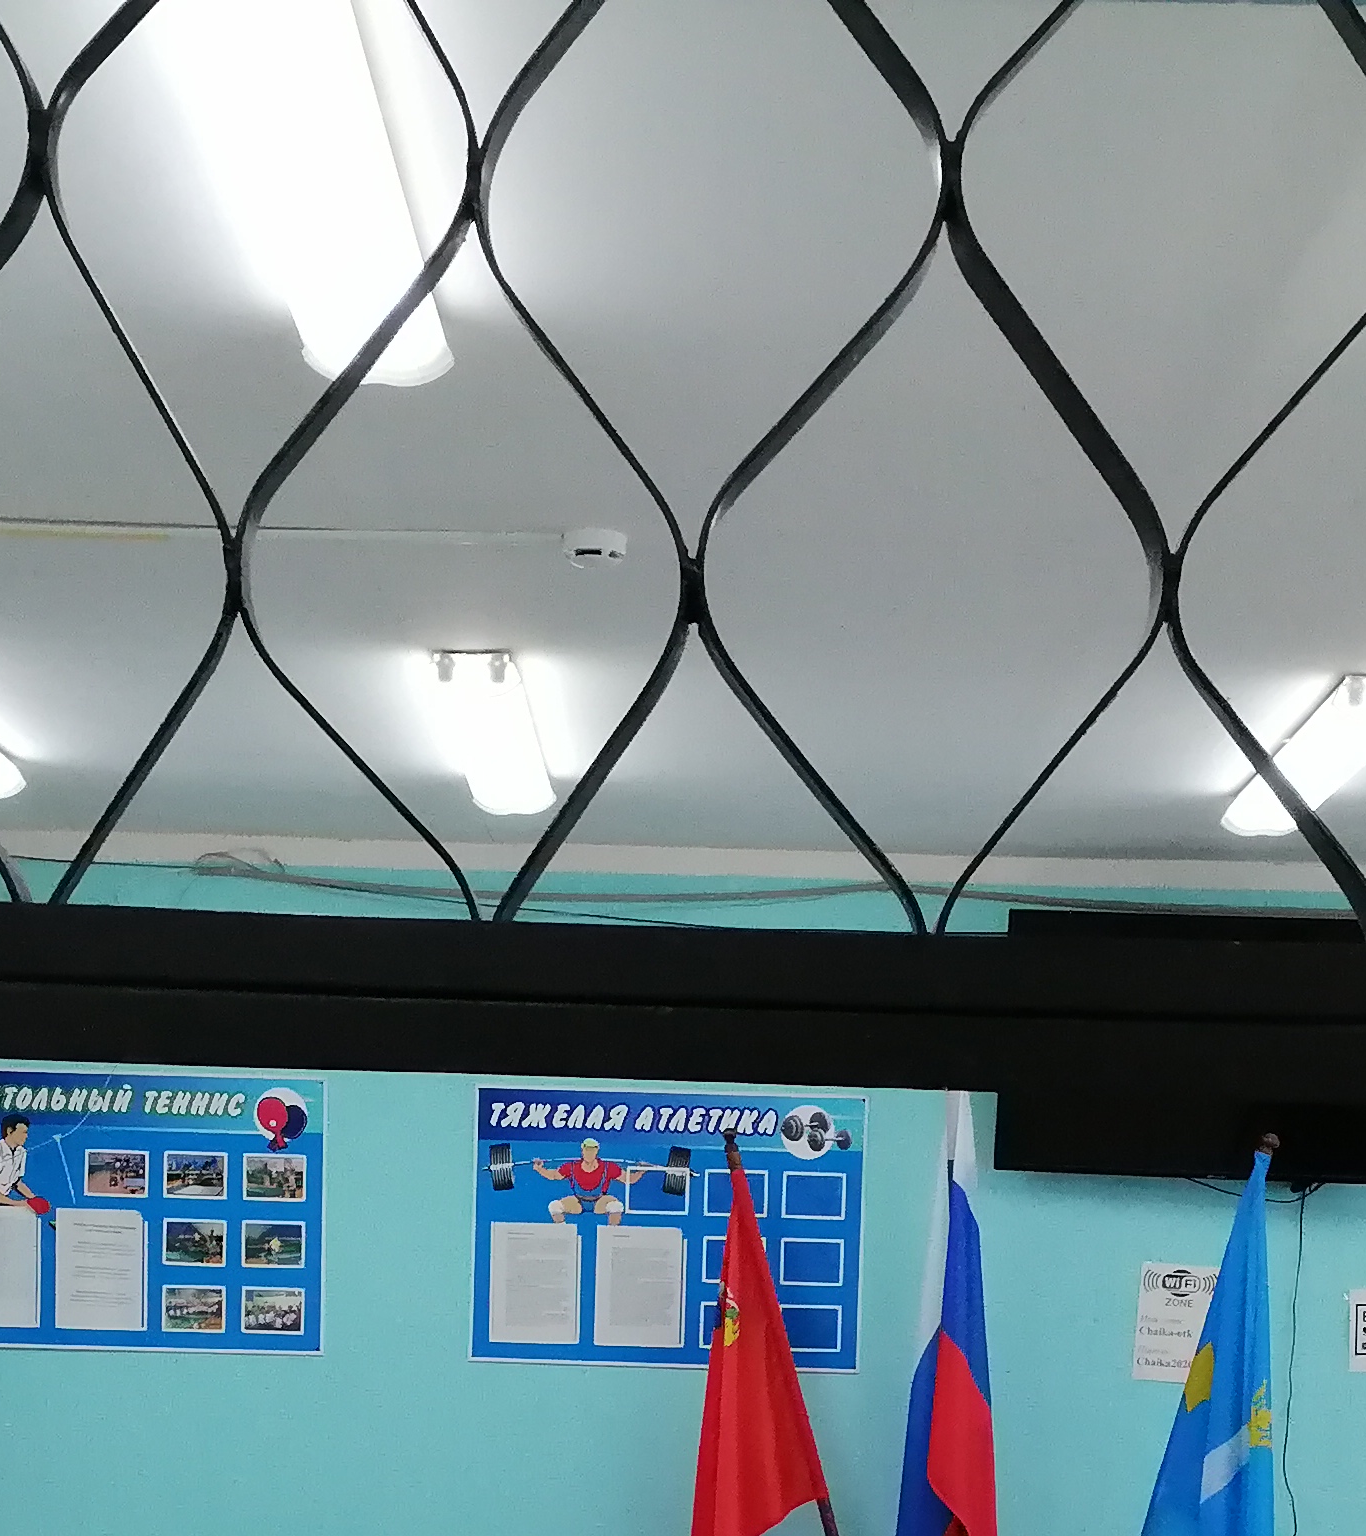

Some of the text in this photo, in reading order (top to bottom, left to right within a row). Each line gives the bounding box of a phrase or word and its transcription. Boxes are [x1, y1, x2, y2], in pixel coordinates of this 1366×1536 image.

[144, 1090, 245, 1117] ТЕННИС
[490, 1102, 778, 1135] ТЯЖЕЛАЯ АТЛЕТИКА
[1164, 1297, 1194, 1308] ZONE
